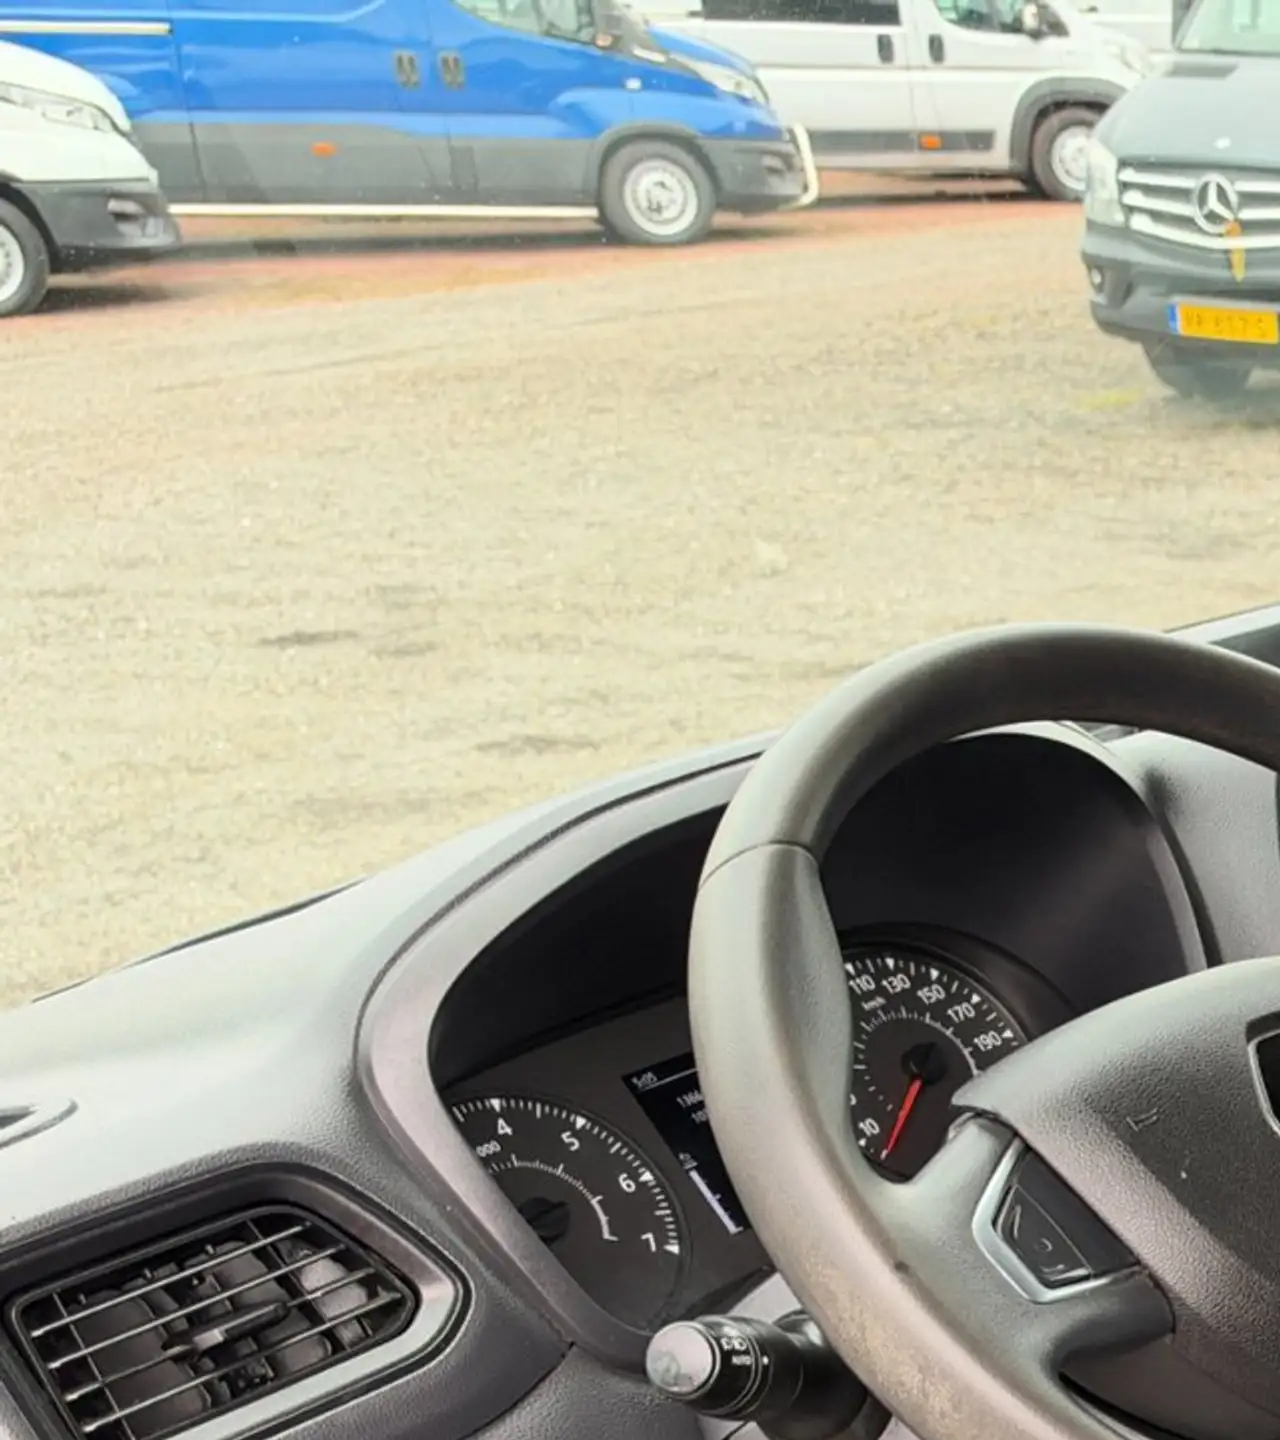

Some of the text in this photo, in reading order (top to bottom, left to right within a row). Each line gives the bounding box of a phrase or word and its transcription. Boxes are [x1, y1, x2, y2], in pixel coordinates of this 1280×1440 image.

[849, 974, 876, 995] 110
[881, 973, 911, 994] 130
[917, 984, 946, 1005] 150
[947, 1002, 976, 1023] 170
[973, 1030, 1002, 1052] 190
[497, 1118, 513, 1136] 4
[859, 1118, 880, 1136] 10
[560, 1130, 581, 1151] 5
[617, 1173, 637, 1193] 6
[641, 1232, 657, 1252] 7
[731, 1354, 753, 1366] AUTO
